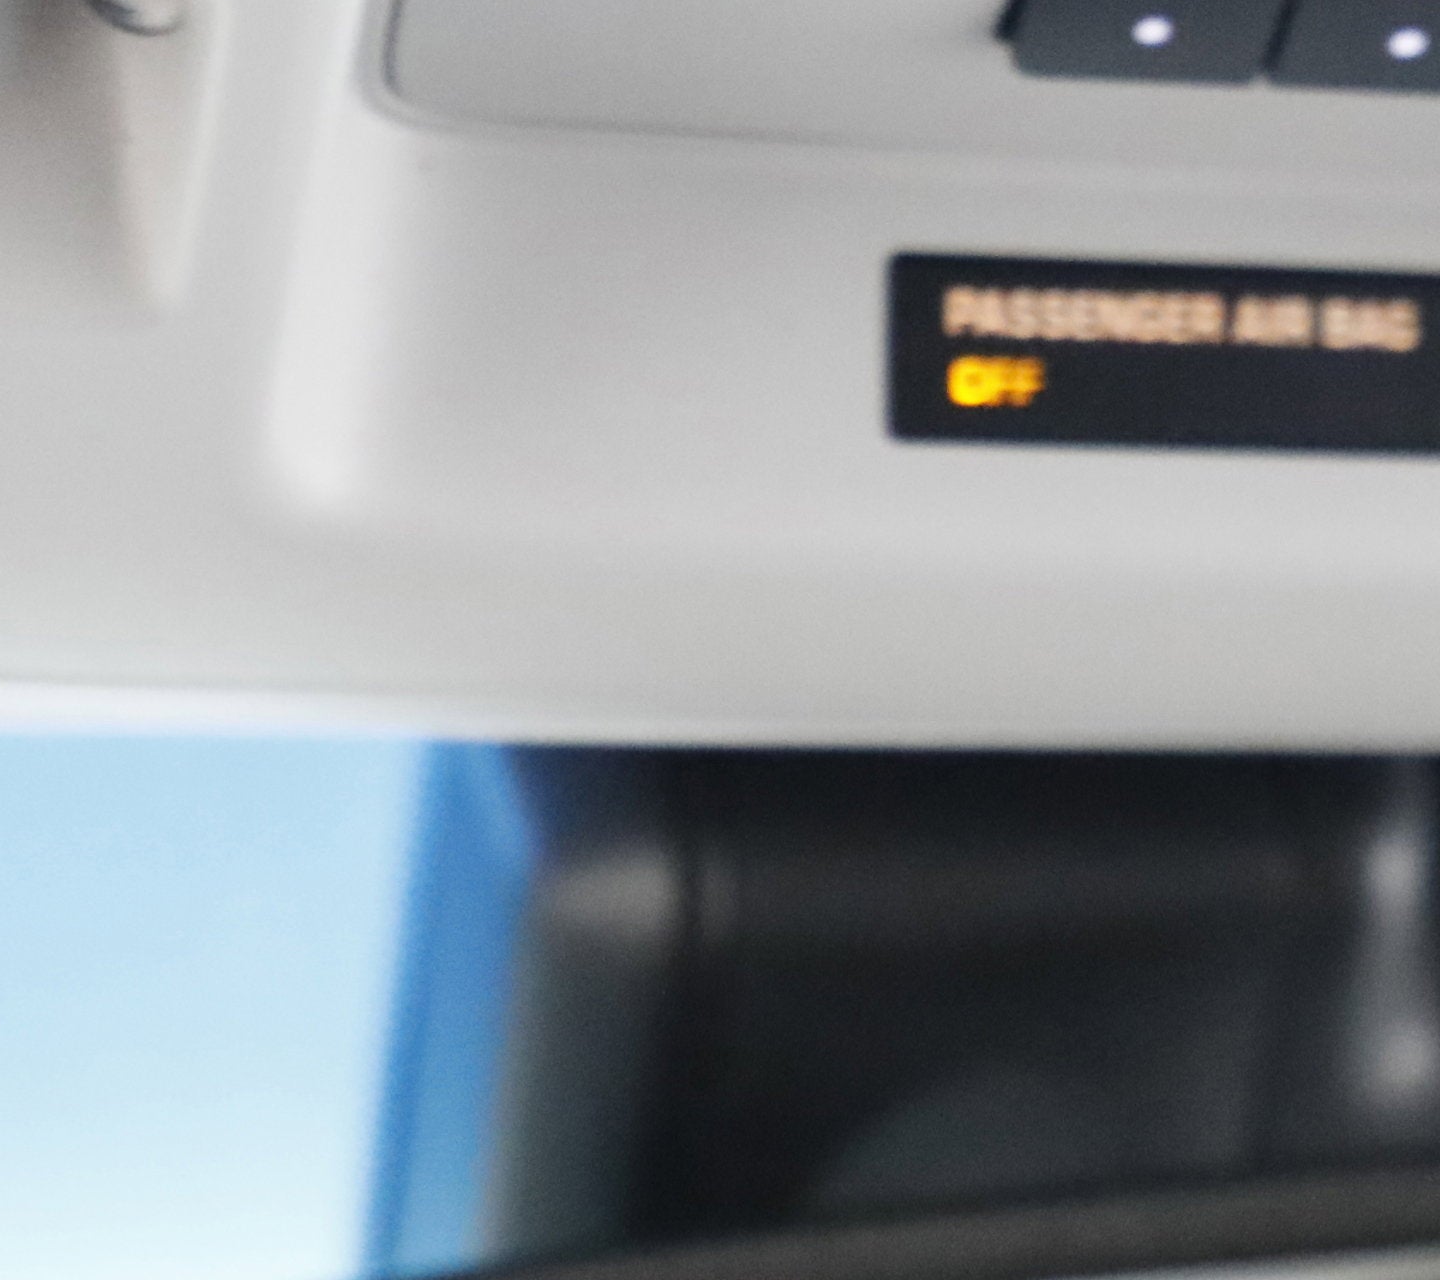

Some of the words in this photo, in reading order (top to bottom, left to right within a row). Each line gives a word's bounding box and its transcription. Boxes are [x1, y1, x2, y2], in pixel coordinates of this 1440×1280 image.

[942, 285, 1226, 345] PASSENGER
[1232, 294, 1315, 348] AIR
[1320, 296, 1422, 353] BAG
[946, 354, 1046, 408] OFF
